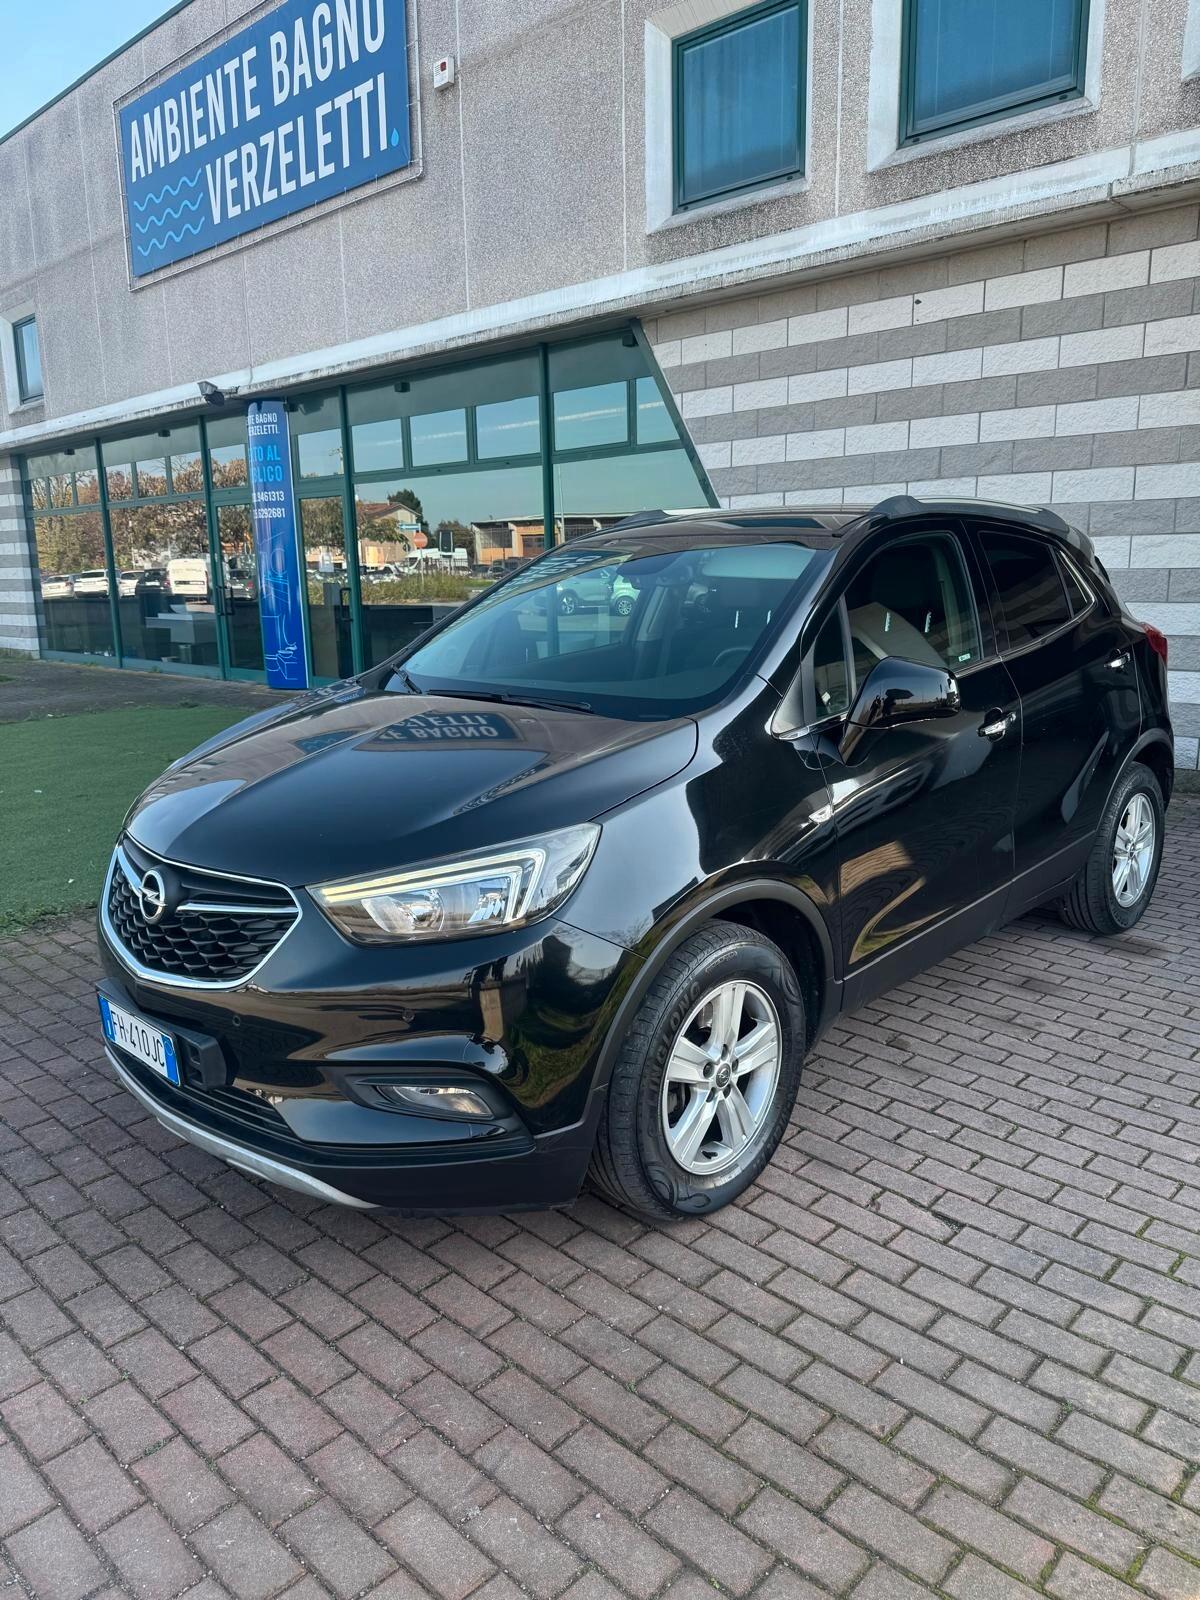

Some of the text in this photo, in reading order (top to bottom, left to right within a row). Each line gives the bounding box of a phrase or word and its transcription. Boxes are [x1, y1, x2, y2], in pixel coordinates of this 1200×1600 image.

[131, 0, 386, 183] AMBIENTE BAGNO
[255, 413, 277, 424] BAGNO
[267, 445, 280, 460] AL
